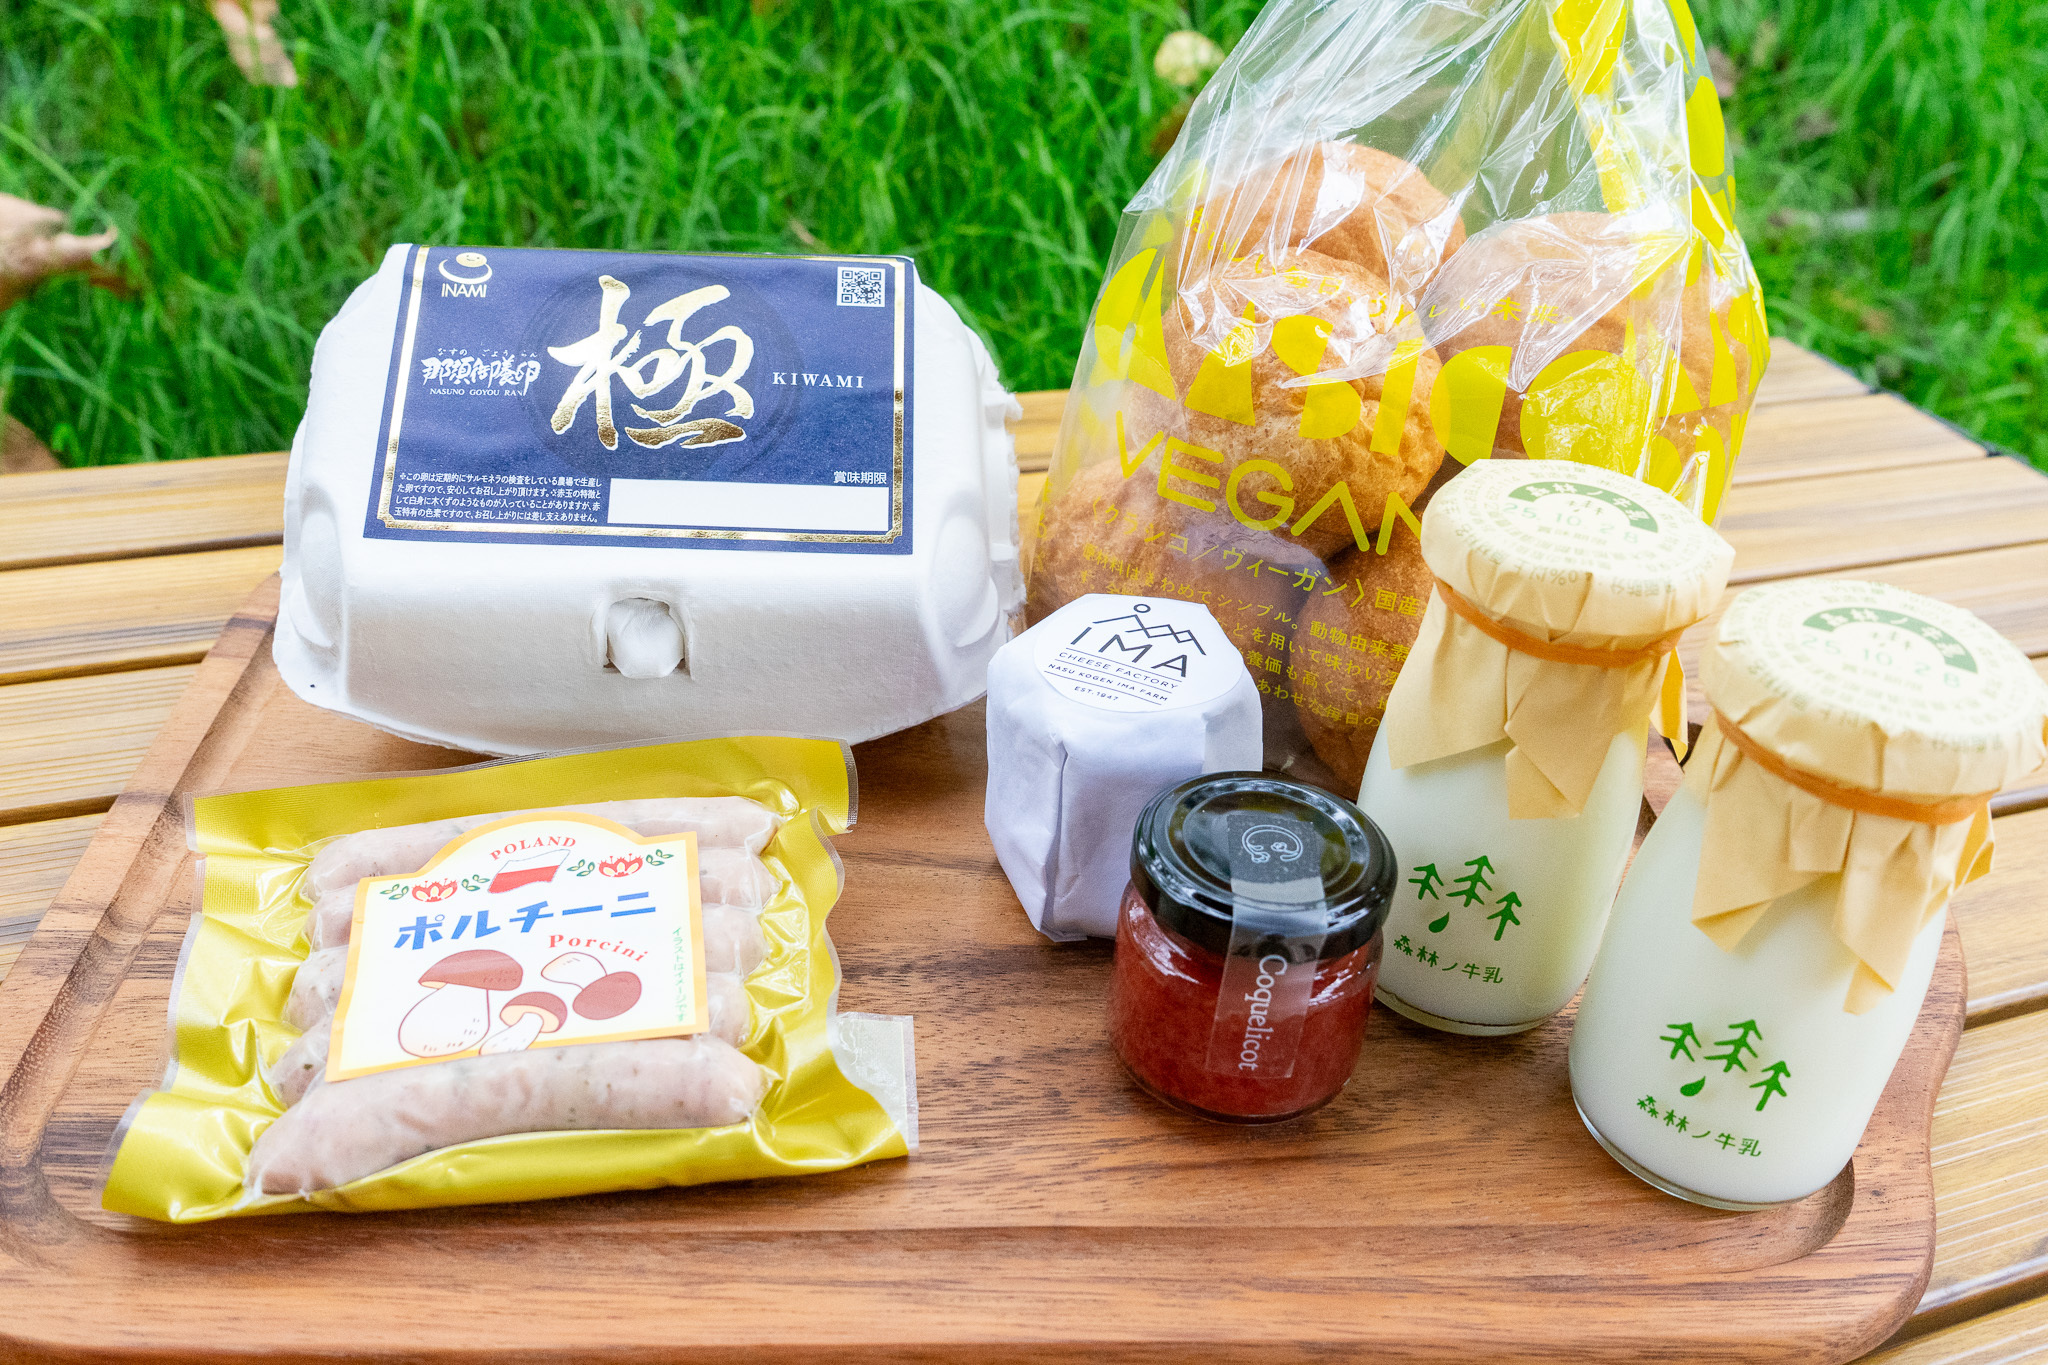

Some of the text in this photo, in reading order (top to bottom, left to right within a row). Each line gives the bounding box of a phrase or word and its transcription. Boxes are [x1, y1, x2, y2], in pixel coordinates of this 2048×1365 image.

[441, 282, 487, 298] INAMI
[547, 275, 755, 450] 極
[772, 371, 864, 389] KIWAMI
[430, 387, 466, 397] NASUNO
[469, 388, 500, 397] GOYOU
[833, 470, 888, 486] 賞味期限
[1058, 651, 1179, 690] CHEESE FACTORY
[1070, 626, 1188, 678] IMA
[1048, 663, 1168, 701] NASU KOGEN IMA FARM
[489, 835, 578, 862] POLAND
[393, 891, 657, 951] ポルチーニ
[548, 933, 650, 963] Porcini
[1393, 934, 1504, 984] 森林ノ牛乳
[672, 926, 688, 1022] イラストはイメージです
[1238, 954, 1288, 1071] Coquelicot
[1636, 1094, 1762, 1157] 森林ノ牛乳
